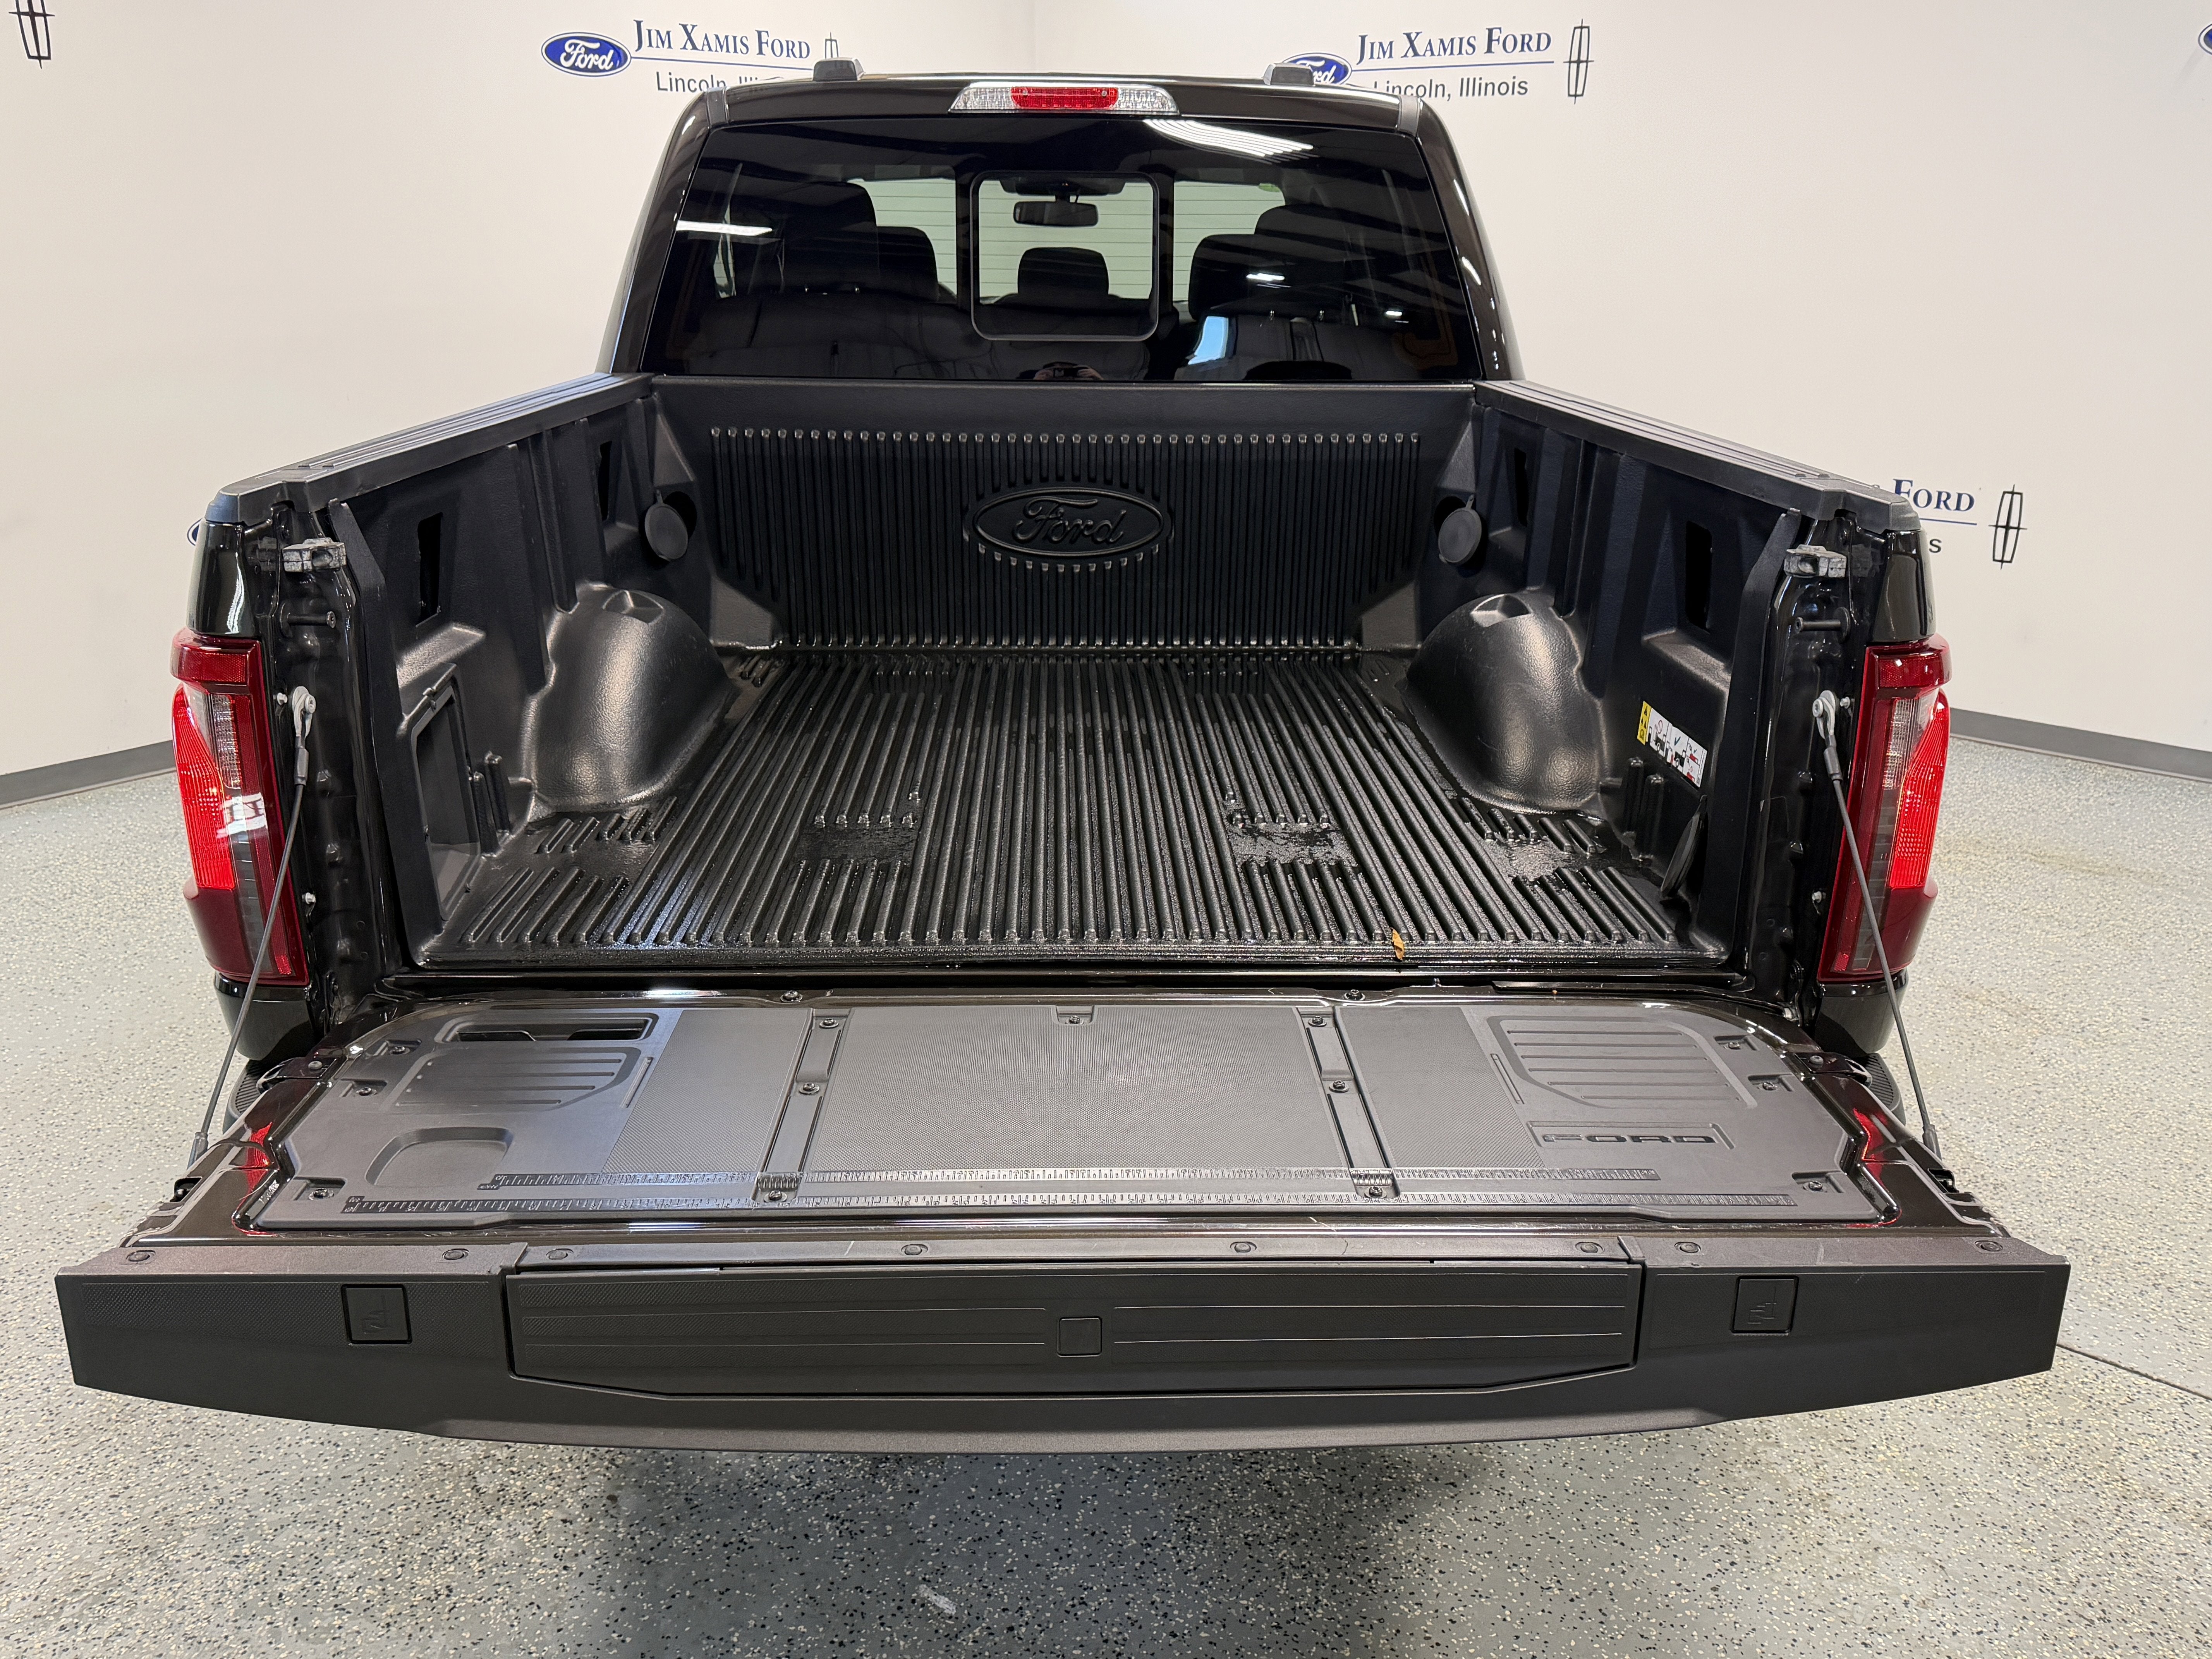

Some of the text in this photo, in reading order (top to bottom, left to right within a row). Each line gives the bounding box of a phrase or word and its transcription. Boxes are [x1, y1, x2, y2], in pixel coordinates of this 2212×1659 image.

[560, 39, 614, 70] Ford
[678, 23, 749, 55] XAMIS
[756, 29, 811, 59] FORD
[1401, 31, 1477, 58] XAMIS
[1484, 27, 1552, 54] FORD
[1459, 77, 1528, 98] Illinois
[1893, 479, 1975, 512] FORD
[1012, 496, 1127, 543] Ford
[1542, 1134, 1717, 1143] FORD
